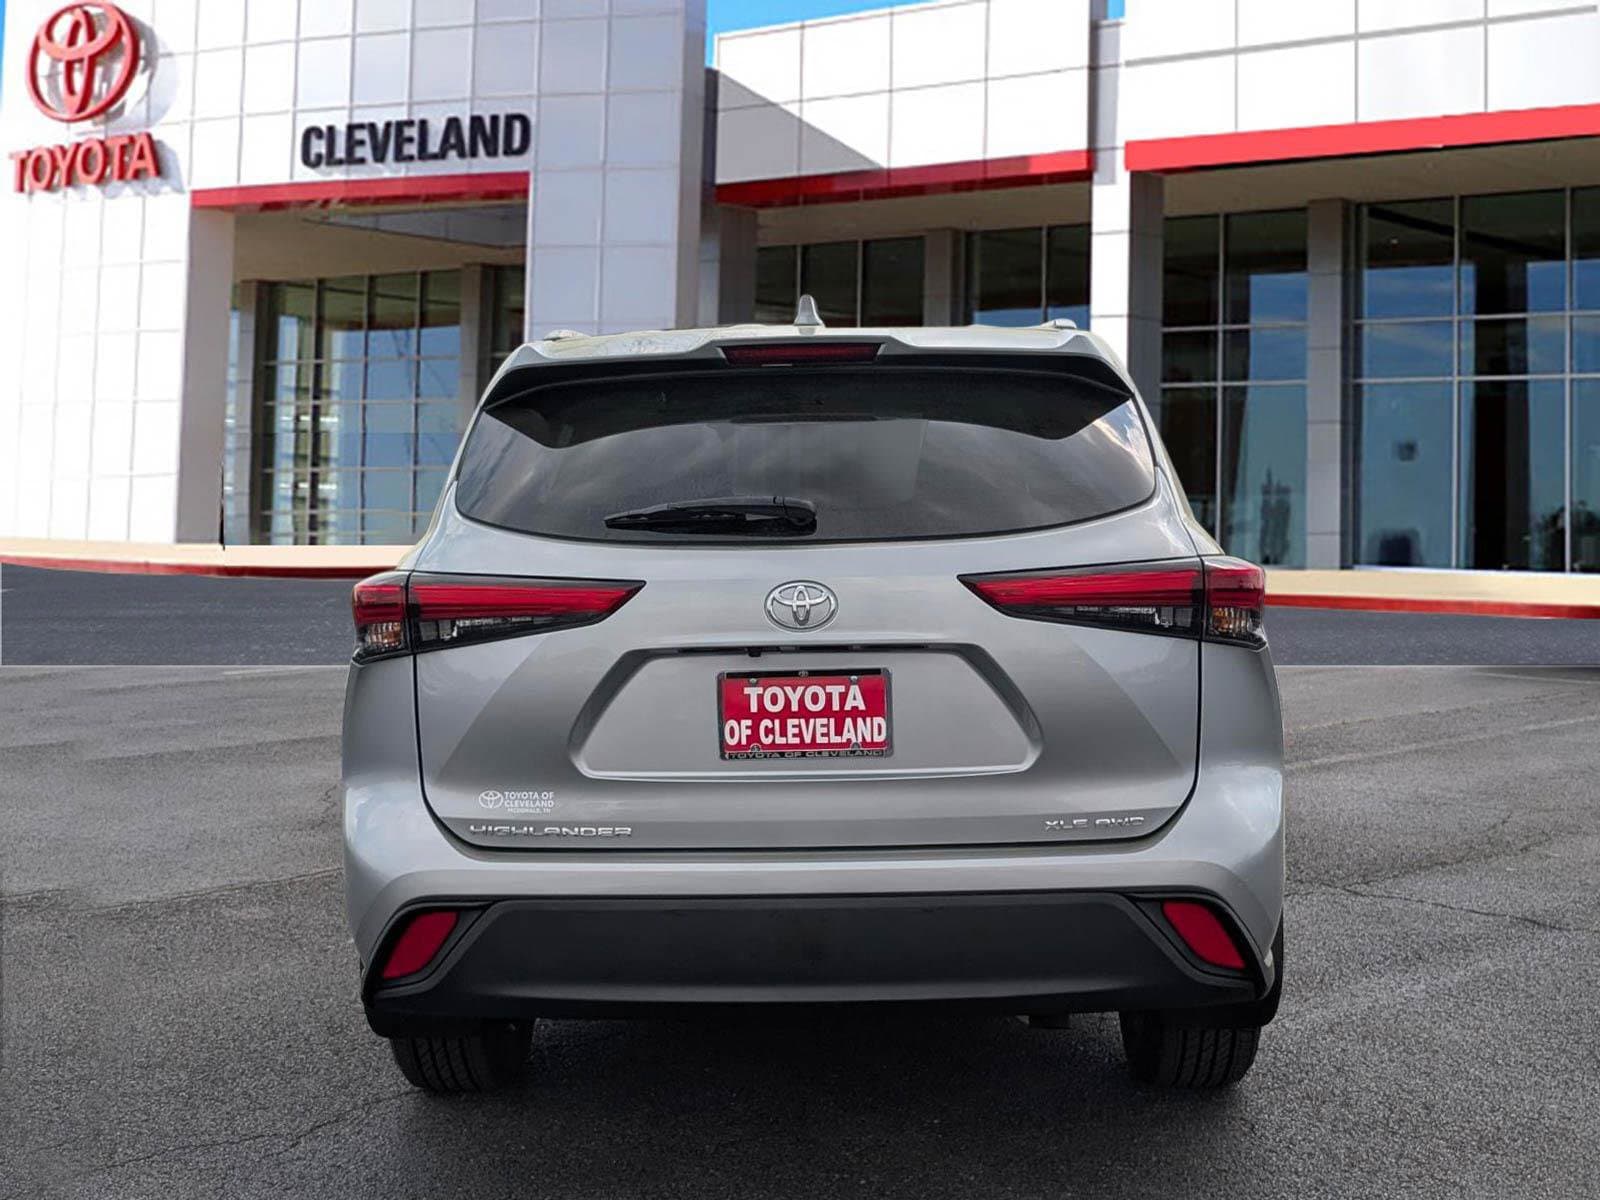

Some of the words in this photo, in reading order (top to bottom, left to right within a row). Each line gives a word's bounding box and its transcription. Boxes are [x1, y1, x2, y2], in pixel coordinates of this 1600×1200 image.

[301, 112, 531, 169] CLEVELAND
[9, 132, 161, 193] TOYOTA
[743, 684, 866, 713] TOYOTA
[724, 719, 752, 746] OF
[759, 716, 887, 744] CLEVELAND
[730, 752, 779, 760] TOYOTA
[805, 750, 882, 758] CLEVELAND
[504, 791, 539, 800] TOYOTA
[541, 791, 554, 800] OF
[504, 800, 555, 808] CLEVELAND
[1045, 819, 1088, 830] XLE
[1095, 816, 1145, 826] AWD
[469, 825, 632, 837] HIGHLANDER
